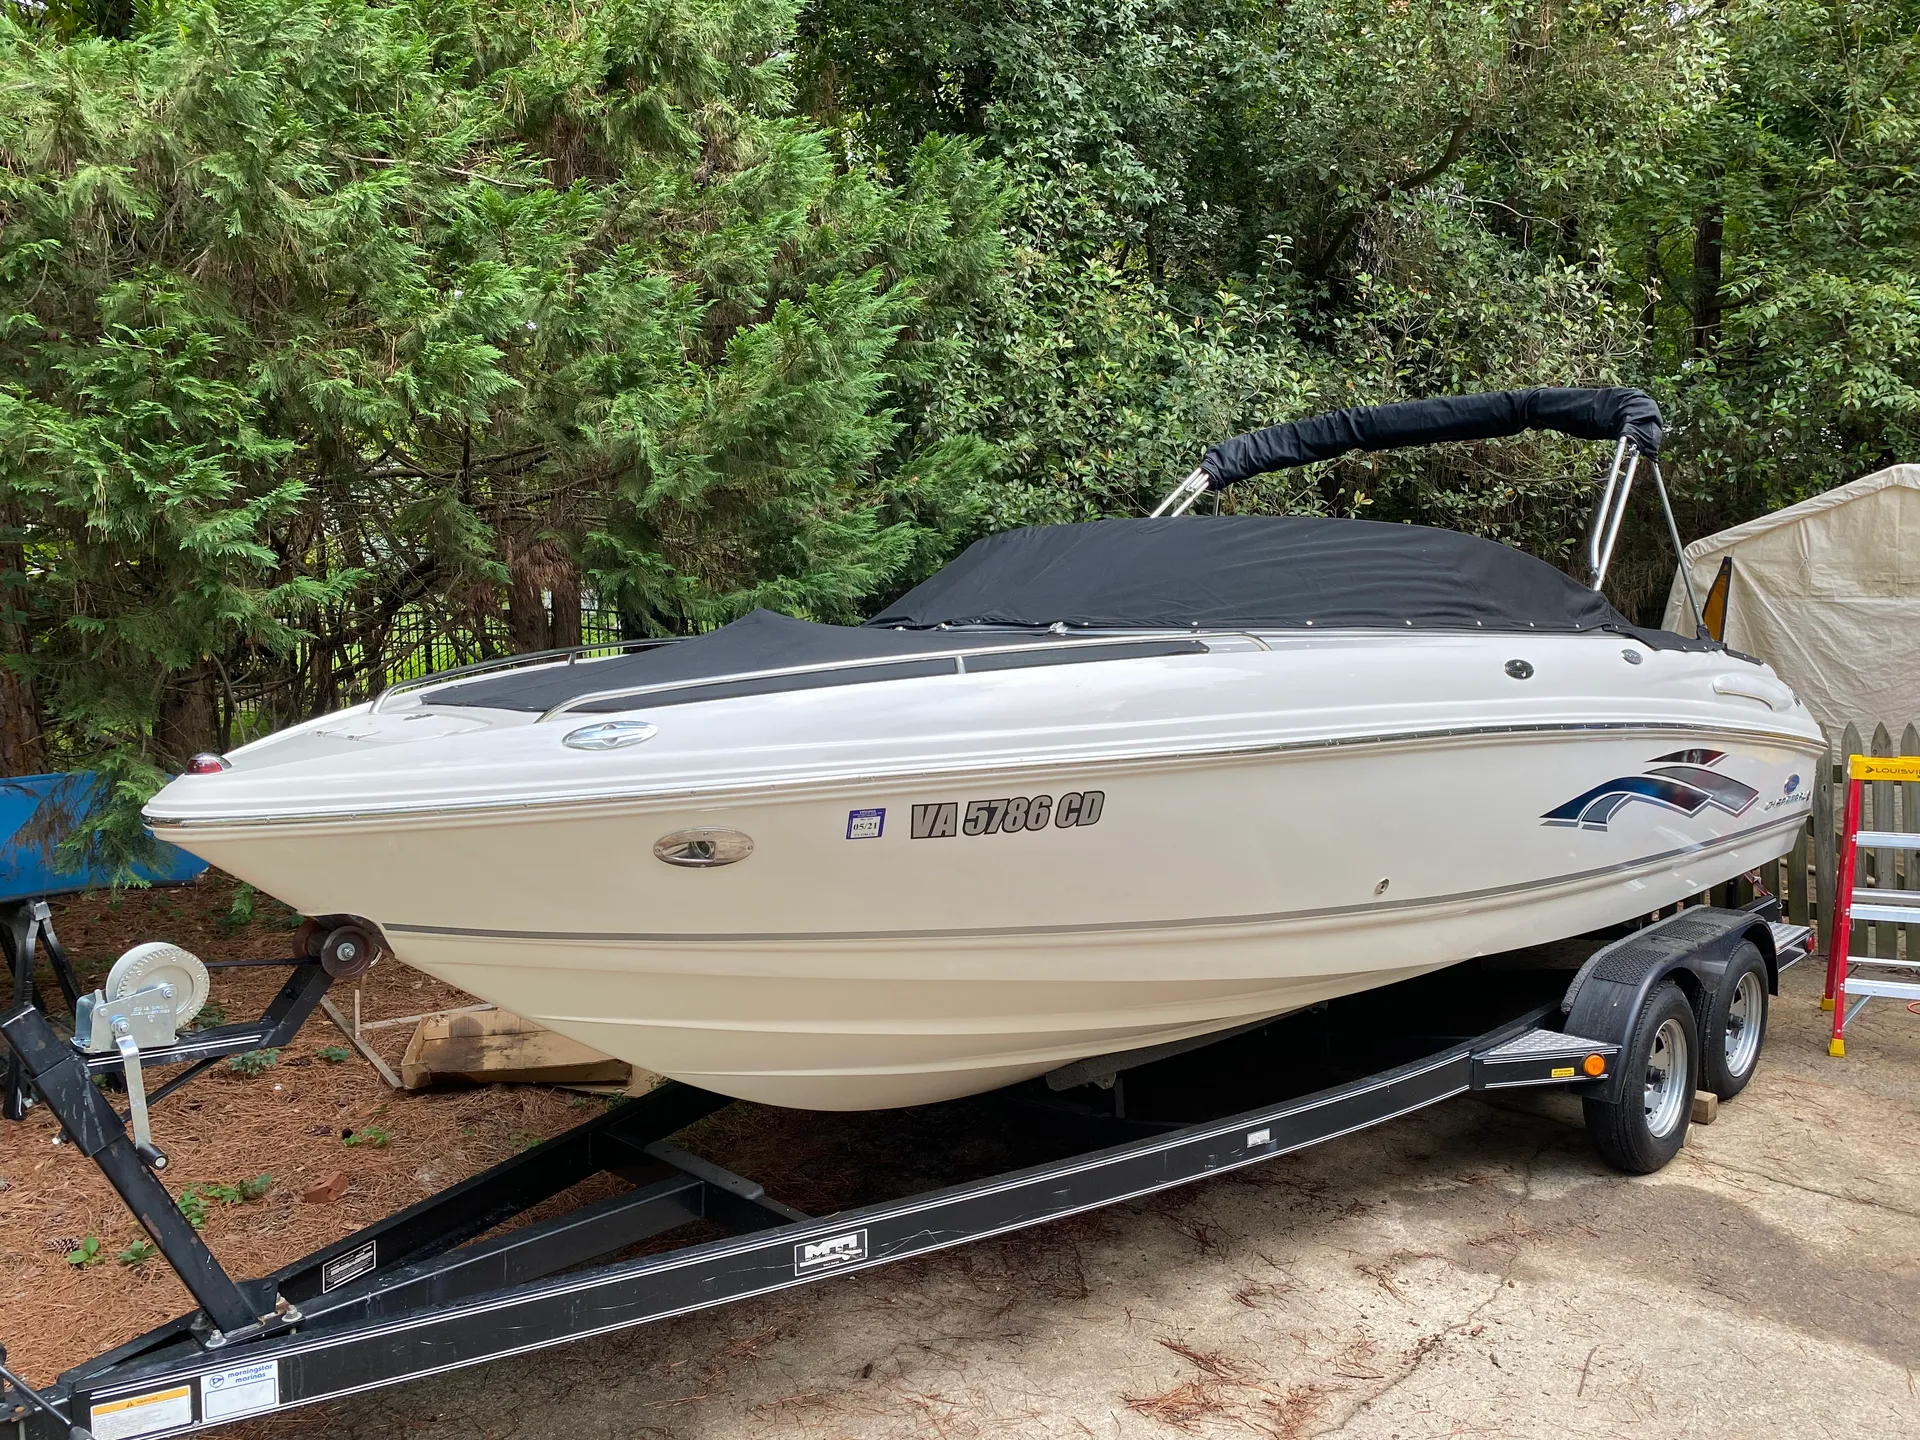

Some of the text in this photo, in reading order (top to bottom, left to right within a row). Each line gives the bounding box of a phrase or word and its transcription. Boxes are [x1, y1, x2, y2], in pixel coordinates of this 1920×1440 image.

[911, 791, 1105, 839] VA 5786 CD
[853, 822, 878, 831] 05/21
[227, 1364, 273, 1378] morningstar
[235, 1372, 266, 1384] marinas
